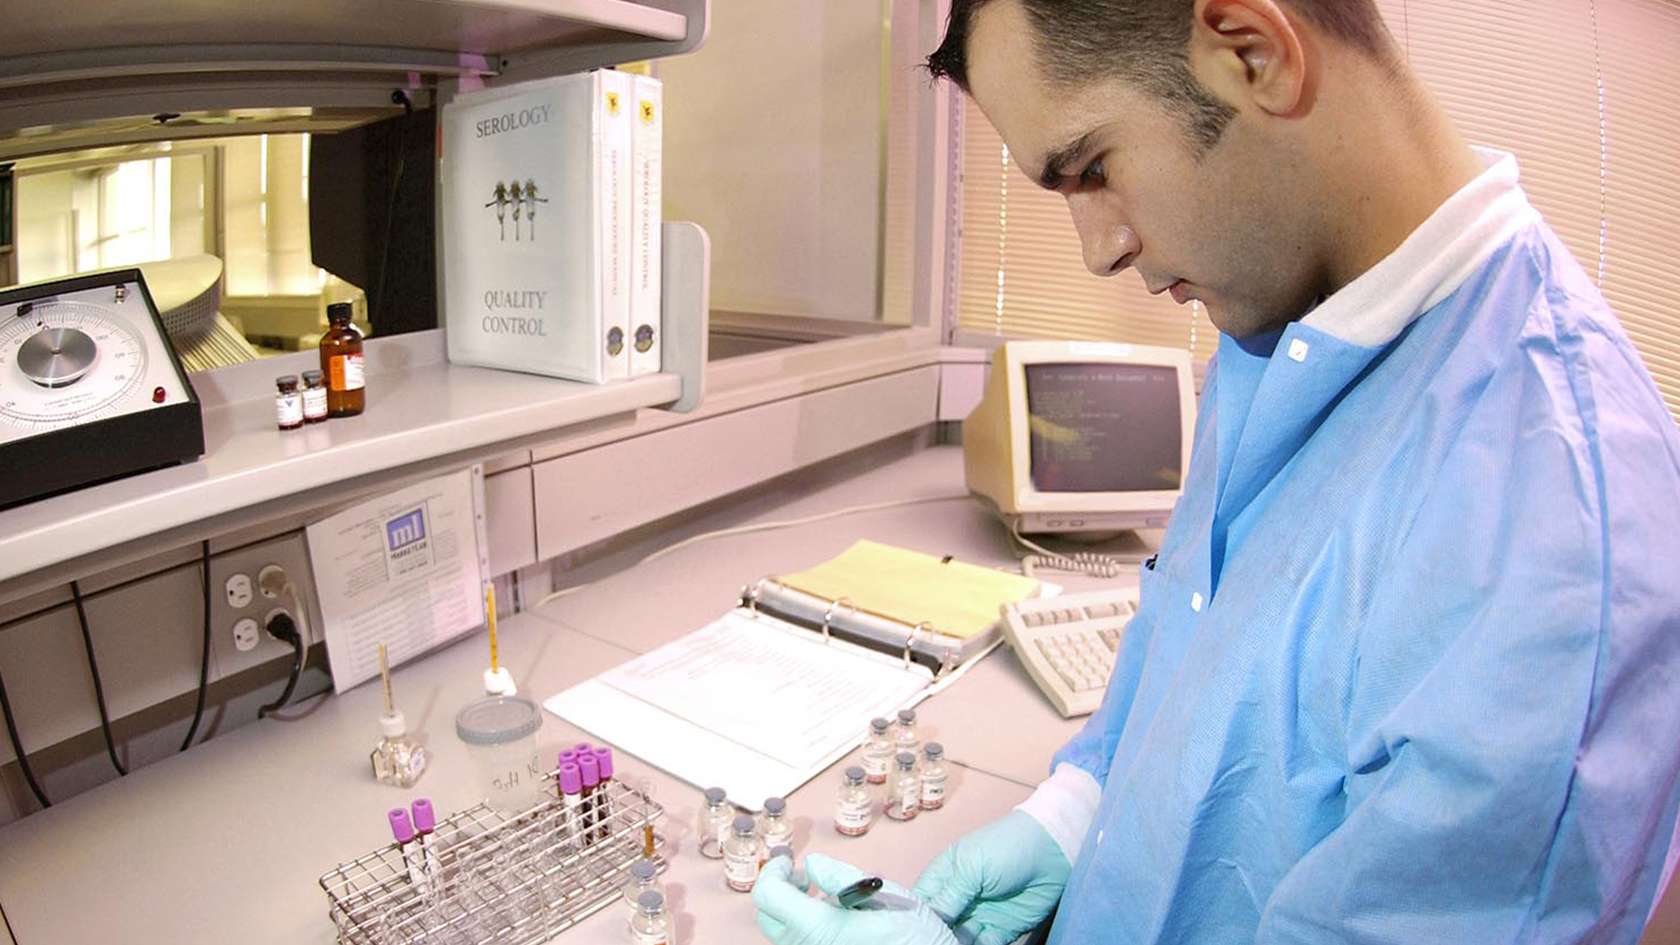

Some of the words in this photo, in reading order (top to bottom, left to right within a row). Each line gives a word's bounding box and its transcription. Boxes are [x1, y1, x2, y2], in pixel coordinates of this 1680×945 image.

[476, 104, 552, 138] SEROLOGY
[484, 290, 548, 311] QUALITY
[482, 316, 547, 336] CONTROL
